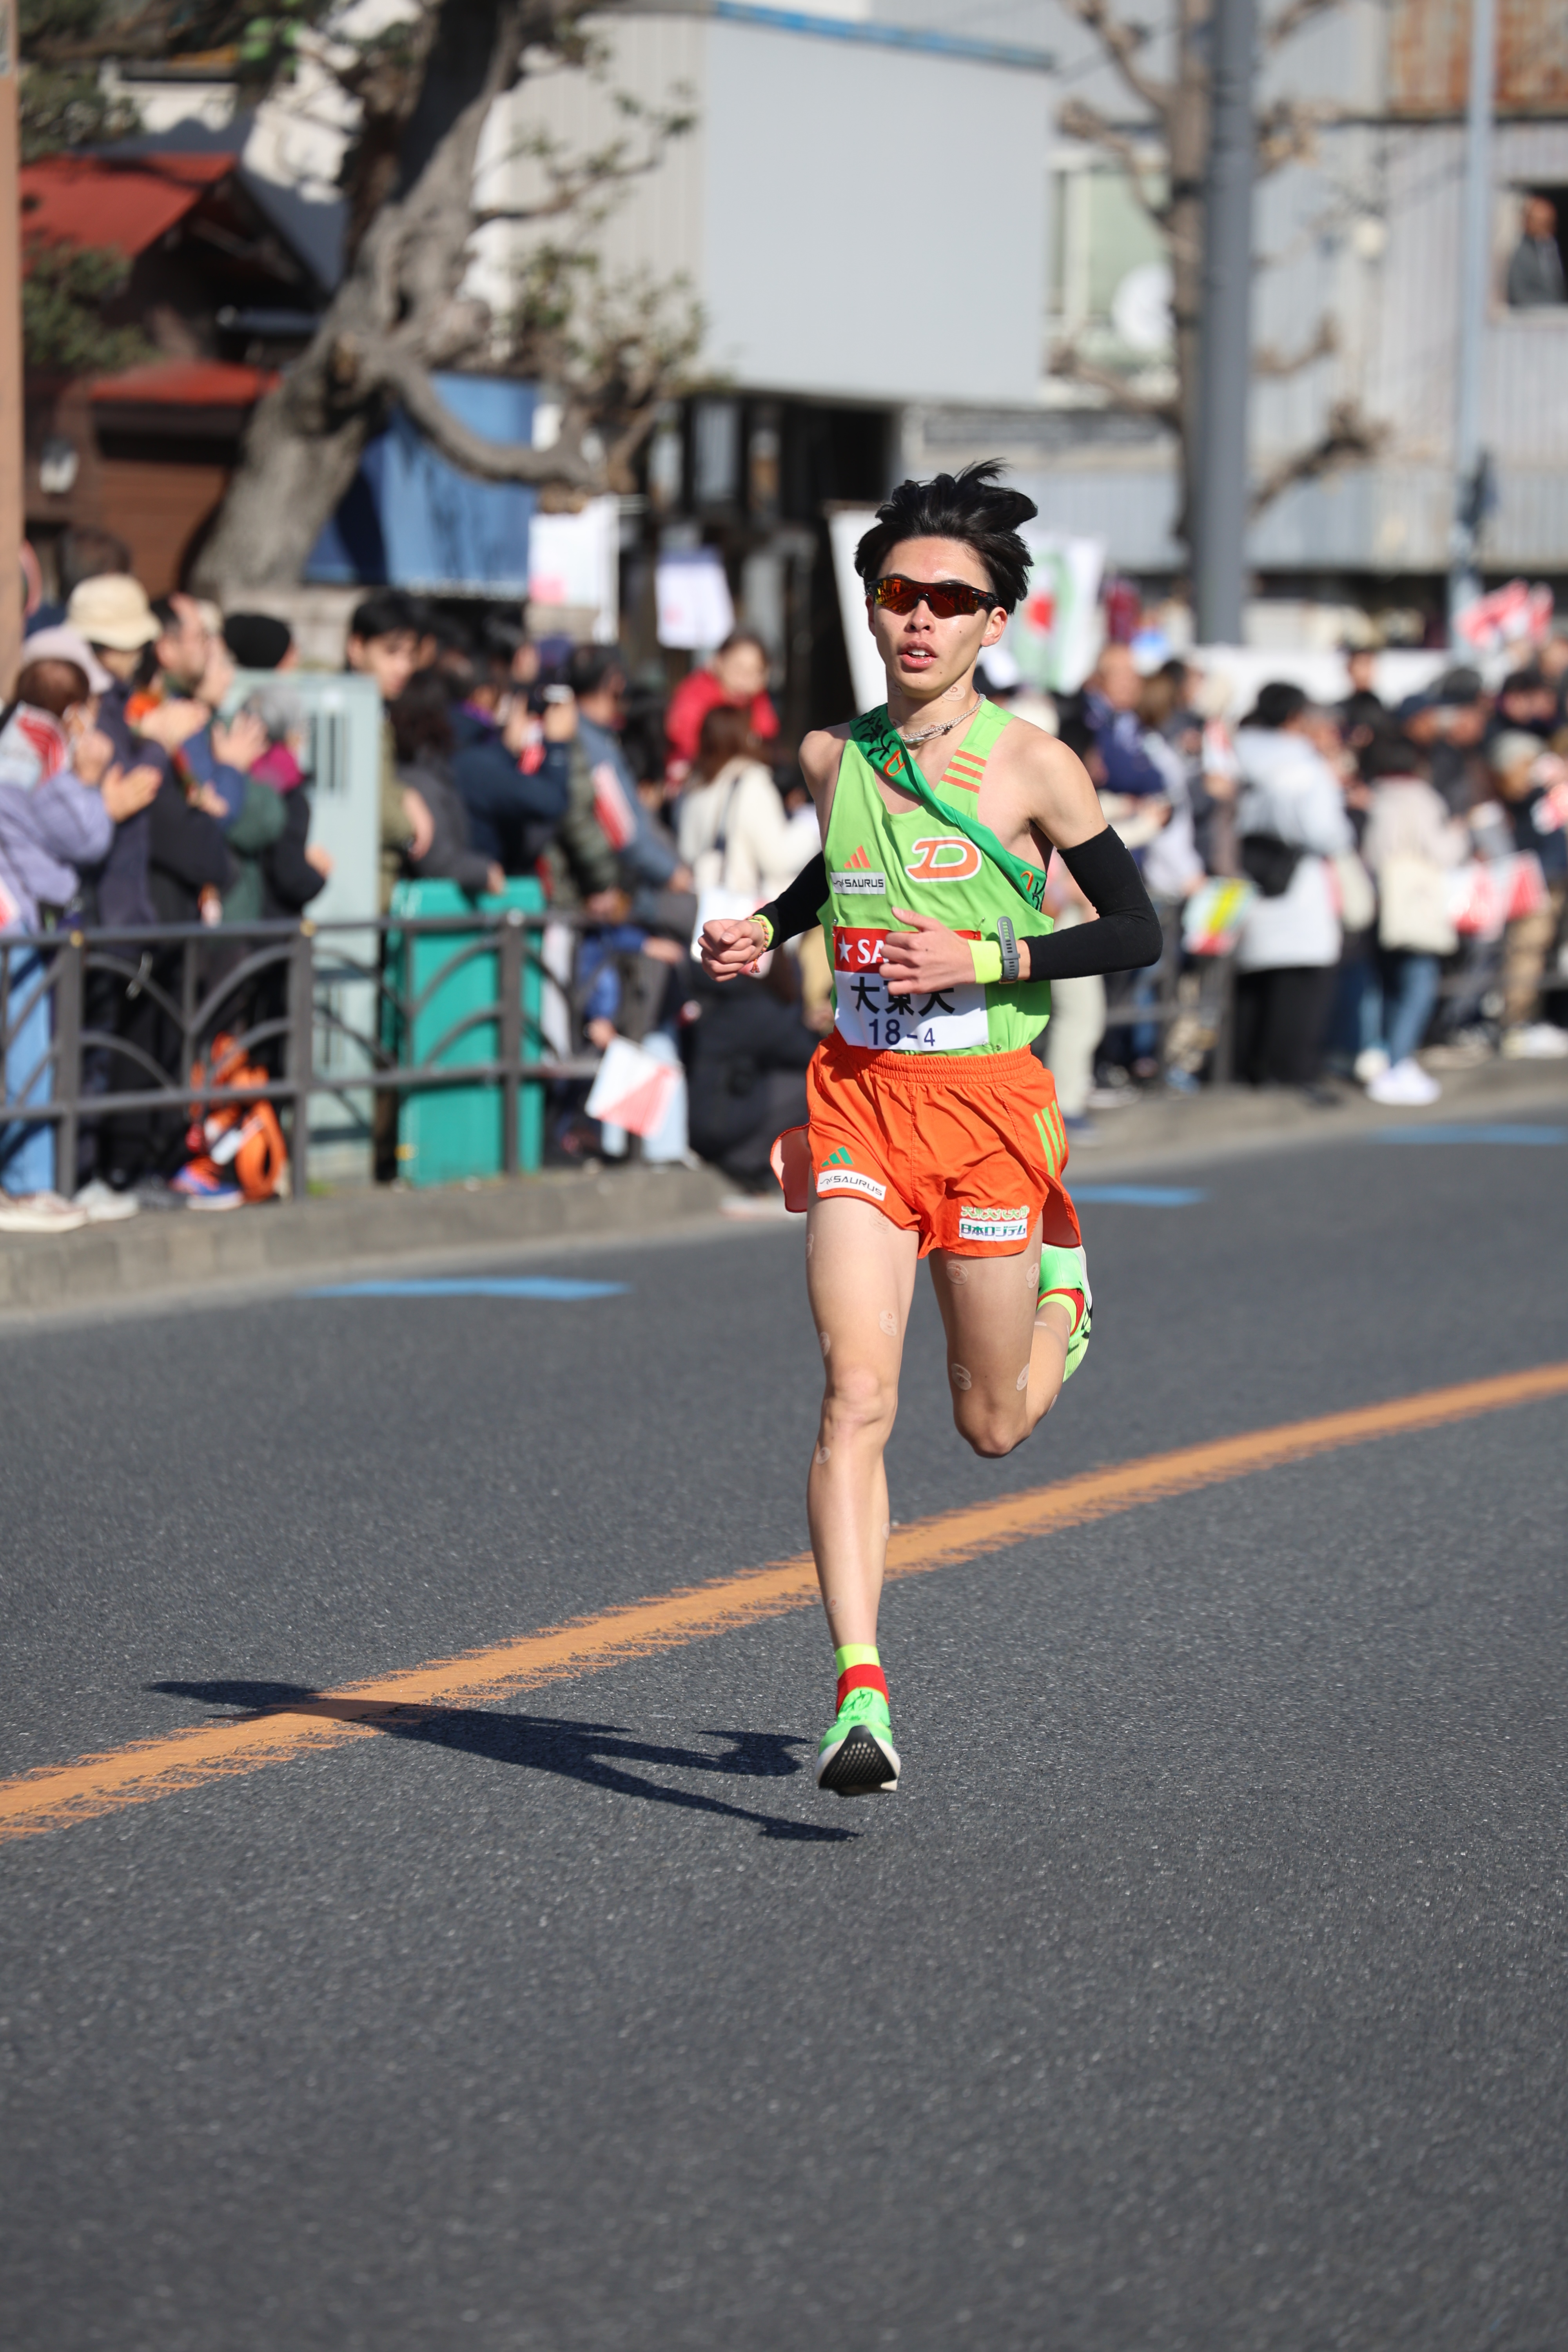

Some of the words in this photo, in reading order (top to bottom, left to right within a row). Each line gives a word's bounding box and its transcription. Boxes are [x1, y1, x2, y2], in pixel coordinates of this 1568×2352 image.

[905, 836, 982, 883] D
[844, 879, 884, 887] SAURUS
[833, 1176, 882, 1196] SAURUS
[961, 1205, 1030, 1220] 大東文化大学
[961, 1224, 1026, 1237] 日本ロジテム
